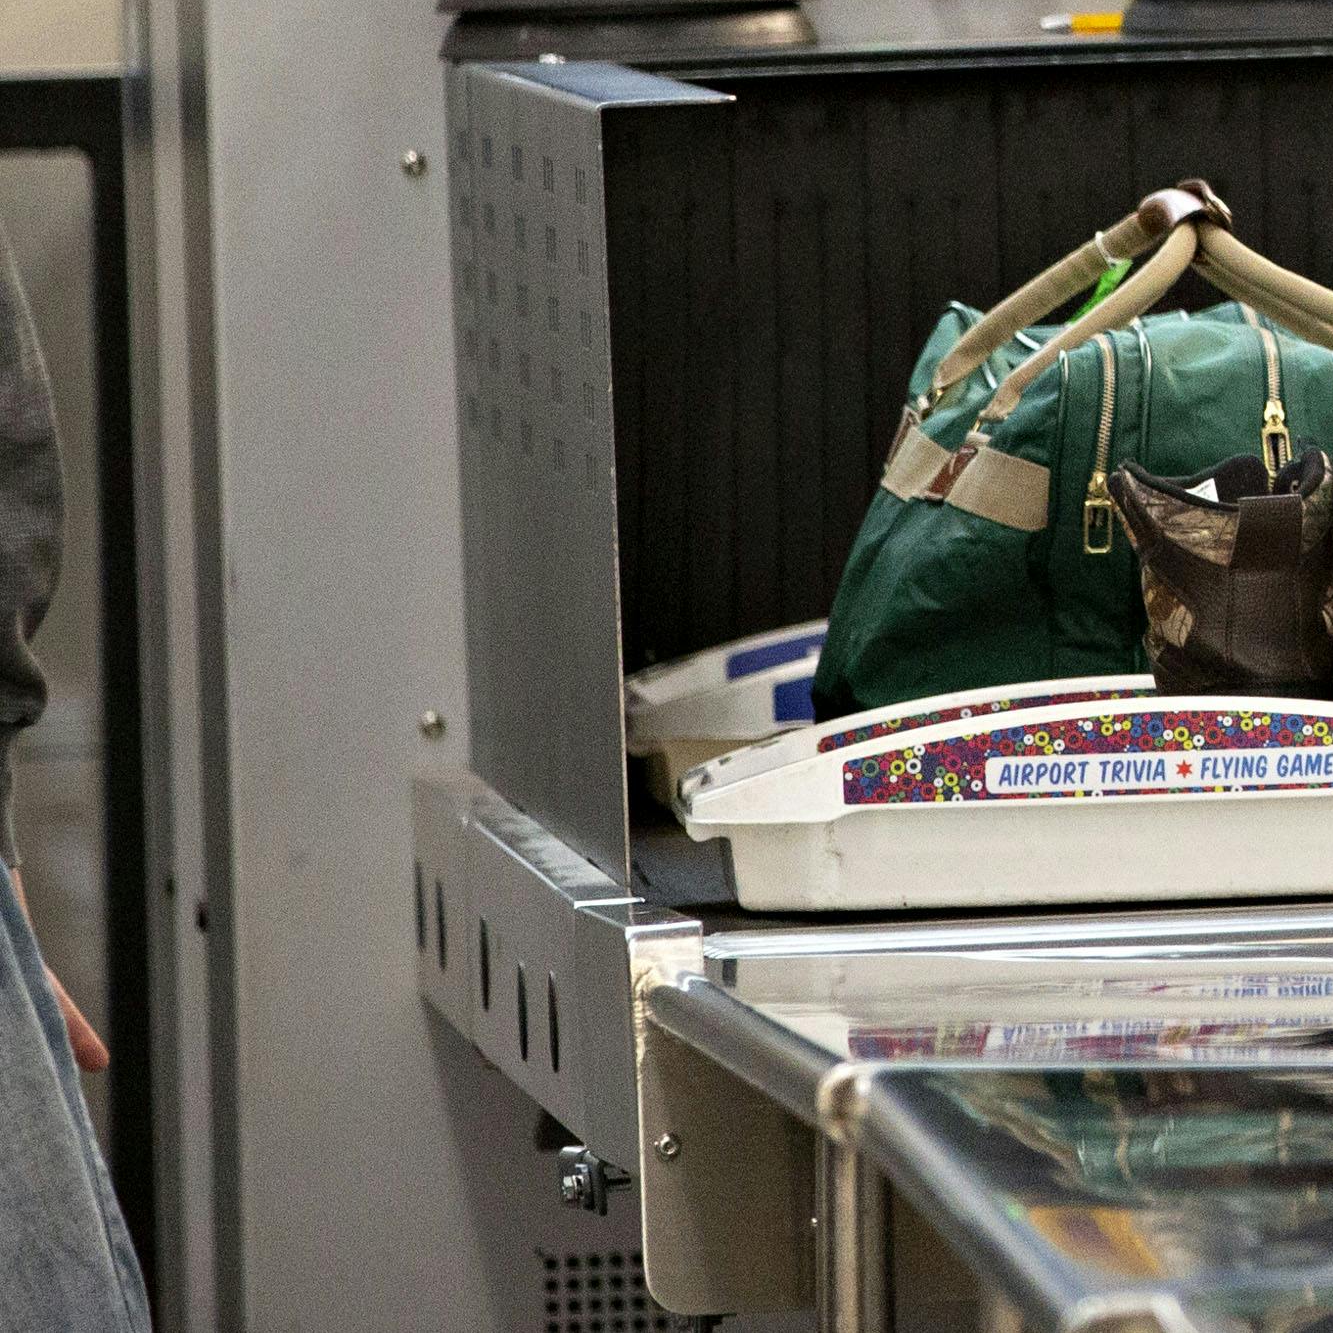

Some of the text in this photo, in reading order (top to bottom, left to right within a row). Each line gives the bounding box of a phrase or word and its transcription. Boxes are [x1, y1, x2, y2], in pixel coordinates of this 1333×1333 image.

[998, 761, 1090, 787] AIRPORT
[1098, 758, 1167, 784] TRIVIA
[1200, 755, 1268, 781] FLYING
